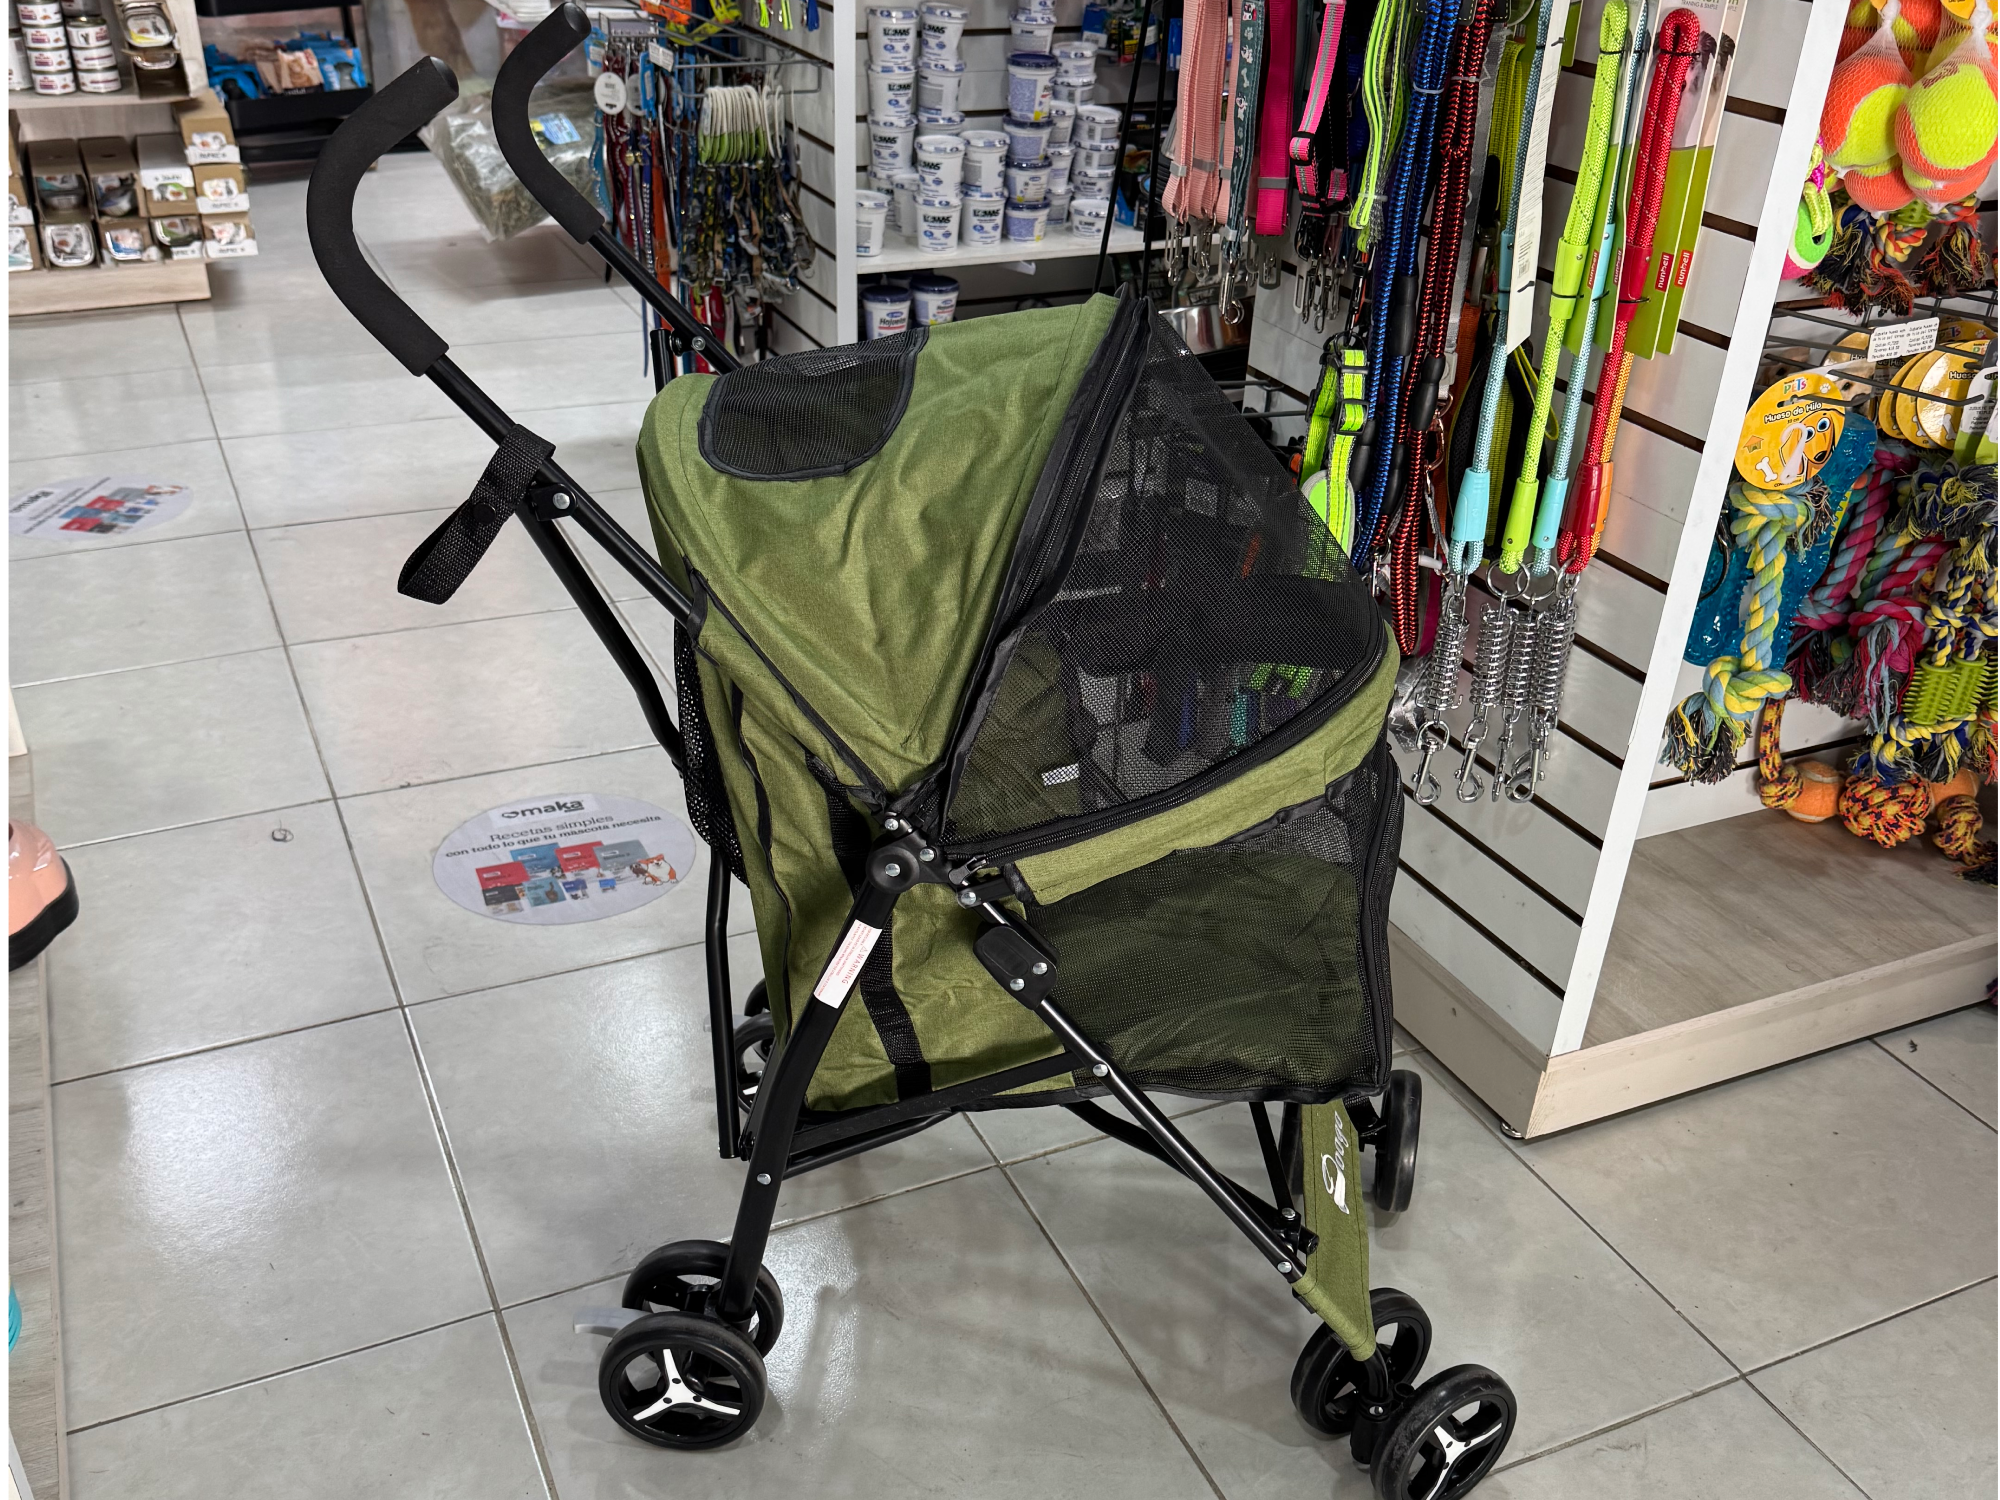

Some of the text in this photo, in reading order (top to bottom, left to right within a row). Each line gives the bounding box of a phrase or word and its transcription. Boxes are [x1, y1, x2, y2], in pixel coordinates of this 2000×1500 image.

[1658, 255, 1670, 288] nunbell
[1678, 252, 1690, 285] nunbell
[1764, 402, 1822, 424] Hueso de Hilo
[446, 849, 470, 858] con
[471, 842, 501, 853] todo
[517, 836, 540, 846] que
[560, 825, 610, 838] mascota
[612, 815, 662, 828] necesita
[490, 815, 614, 843] Recetas simples
[841, 953, 866, 985] WARNING
